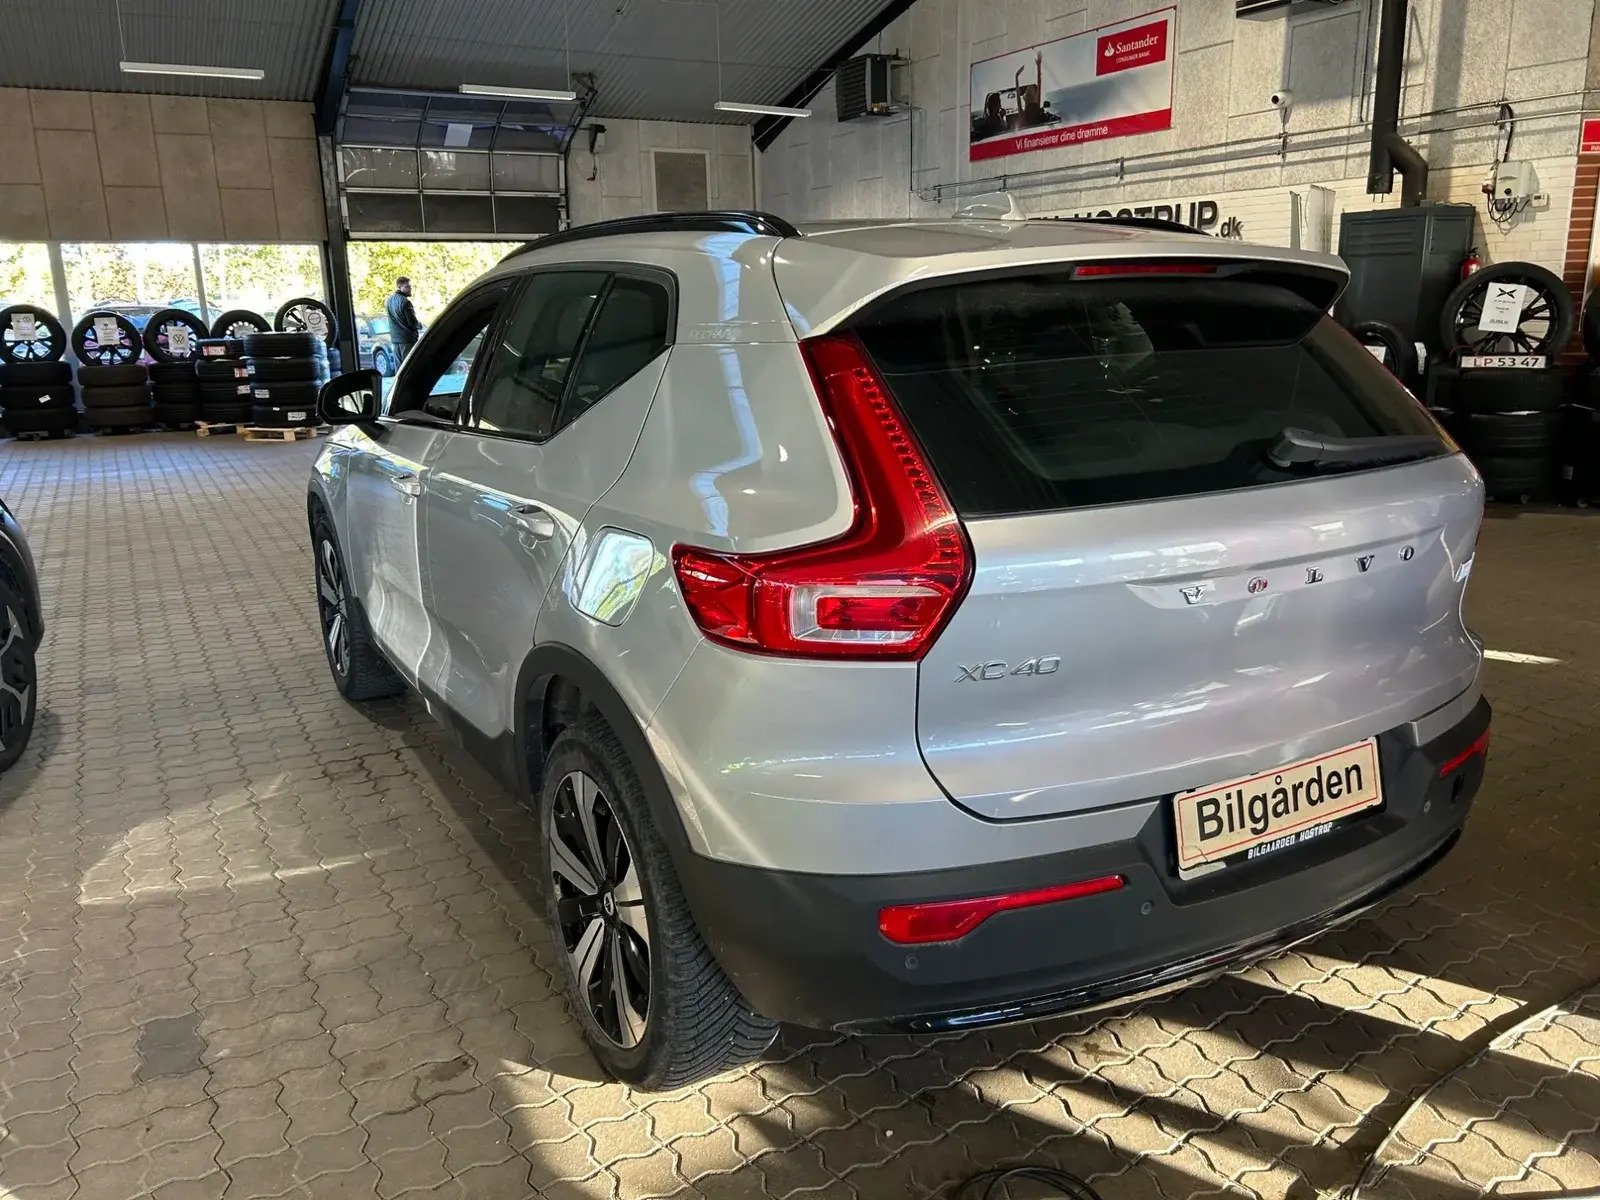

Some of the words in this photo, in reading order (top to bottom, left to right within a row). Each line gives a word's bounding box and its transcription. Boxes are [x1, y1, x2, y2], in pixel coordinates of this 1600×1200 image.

[1115, 33, 1159, 54] Santander
[1115, 53, 1139, 64] CONSUMER
[1139, 50, 1151, 59] BANK
[1015, 138, 1023, 150] Vi
[1024, 134, 1060, 150] finansierer
[1060, 130, 1076, 142] dine
[1077, 125, 1109, 140] drømme
[1074, 200, 1243, 240] TRUP.dk
[1498, 357, 1516, 367] 53
[1521, 357, 1540, 367] 47
[1180, 544, 1415, 605] VOLVO
[1197, 763, 1363, 841] Bilgården
[1248, 835, 1295, 859] BILGAARDEN
[1300, 822, 1333, 843] HOSTRUP
